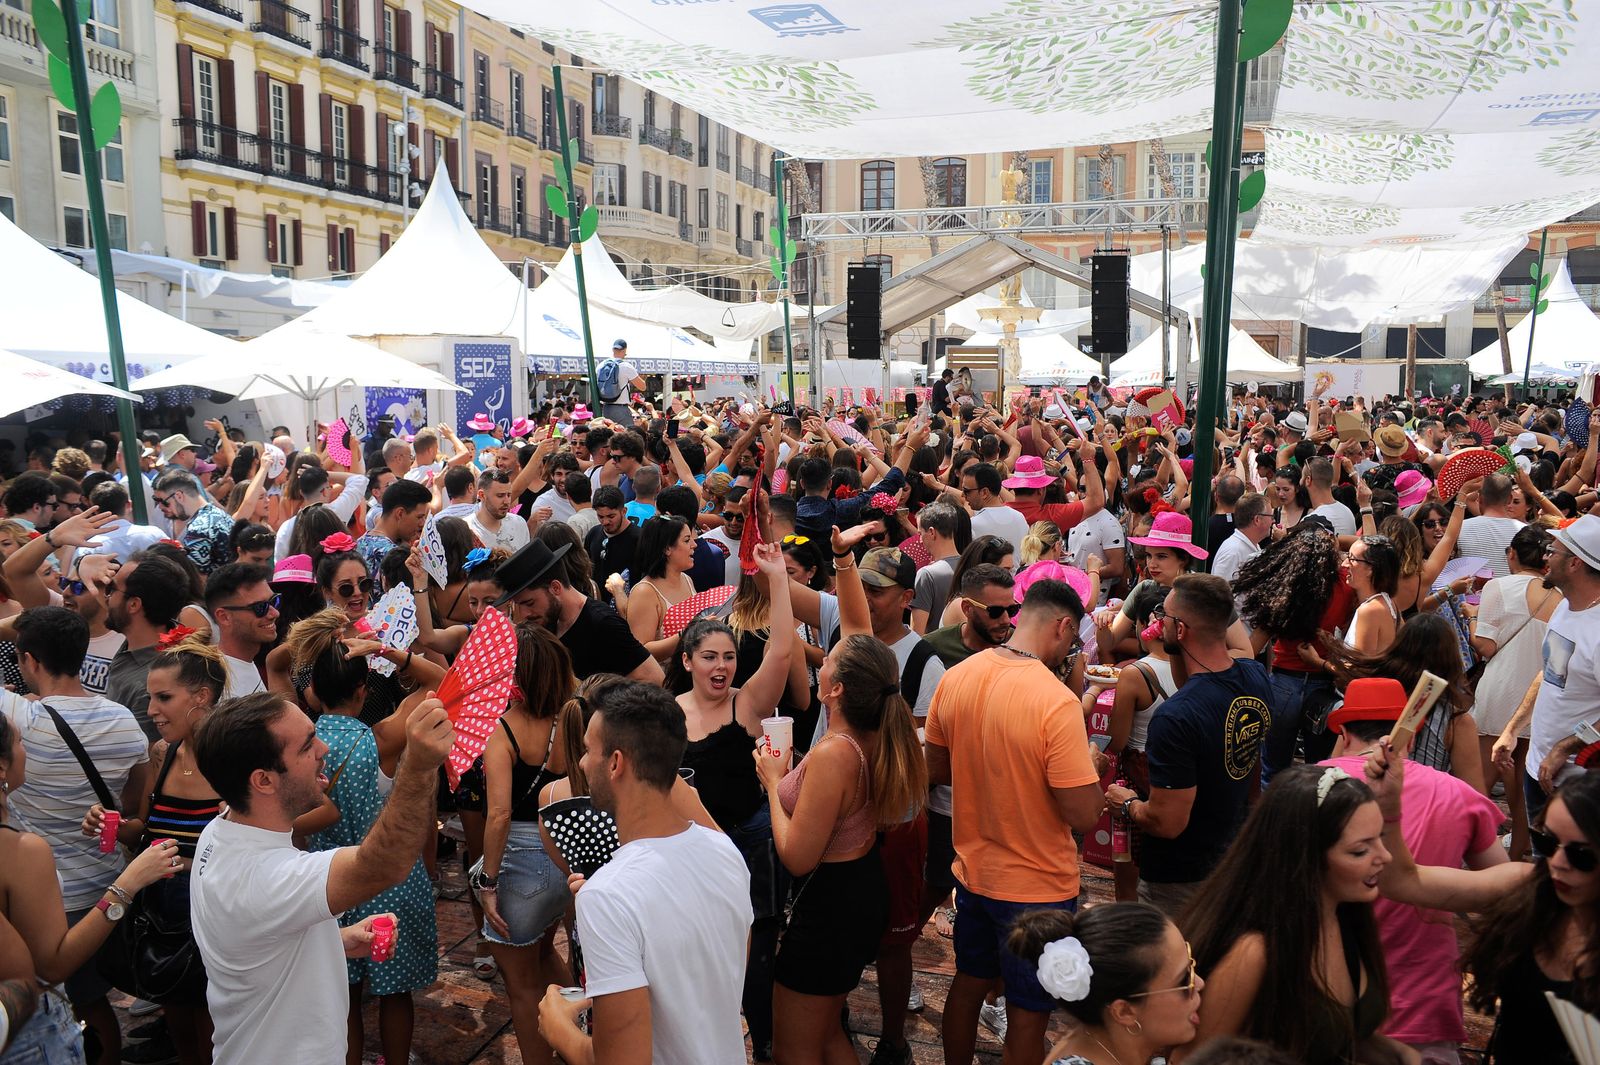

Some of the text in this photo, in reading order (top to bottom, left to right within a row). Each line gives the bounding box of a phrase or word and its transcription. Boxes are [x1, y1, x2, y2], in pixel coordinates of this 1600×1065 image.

[1081, 344, 1093, 353] NE
[461, 357, 496, 378] SER
[426, 519, 445, 566] DECA
[764, 734, 772, 755] GER
